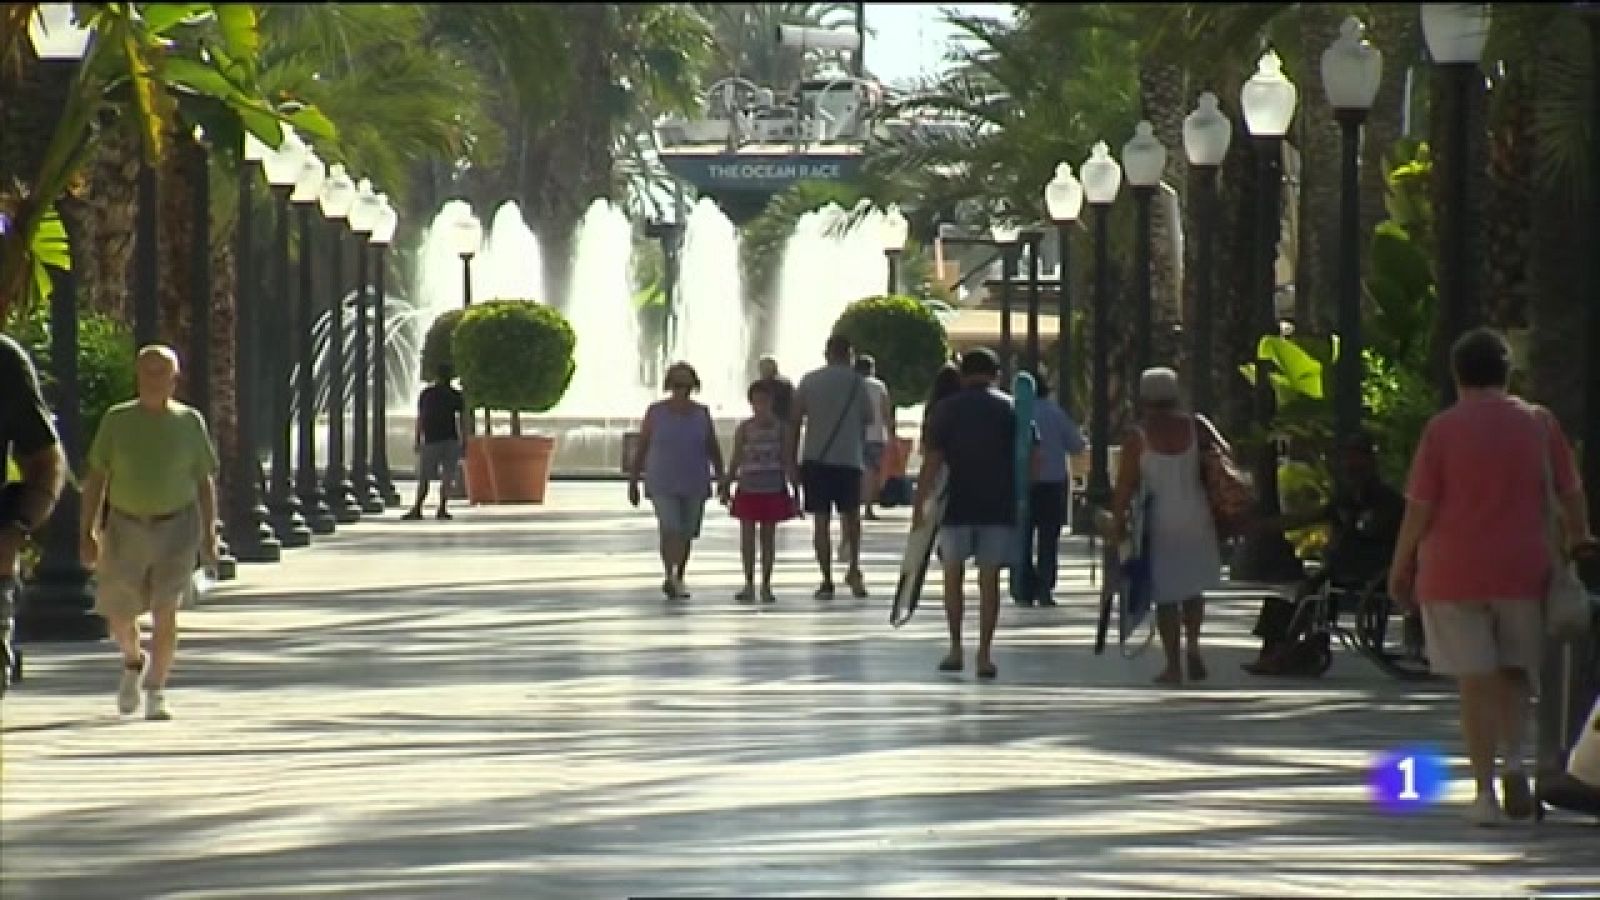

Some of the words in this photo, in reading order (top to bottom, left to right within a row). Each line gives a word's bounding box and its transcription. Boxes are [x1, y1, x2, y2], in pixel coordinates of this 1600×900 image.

[708, 164, 738, 179] THE
[741, 164, 796, 179] OCEAN
[799, 164, 840, 179] RACE
